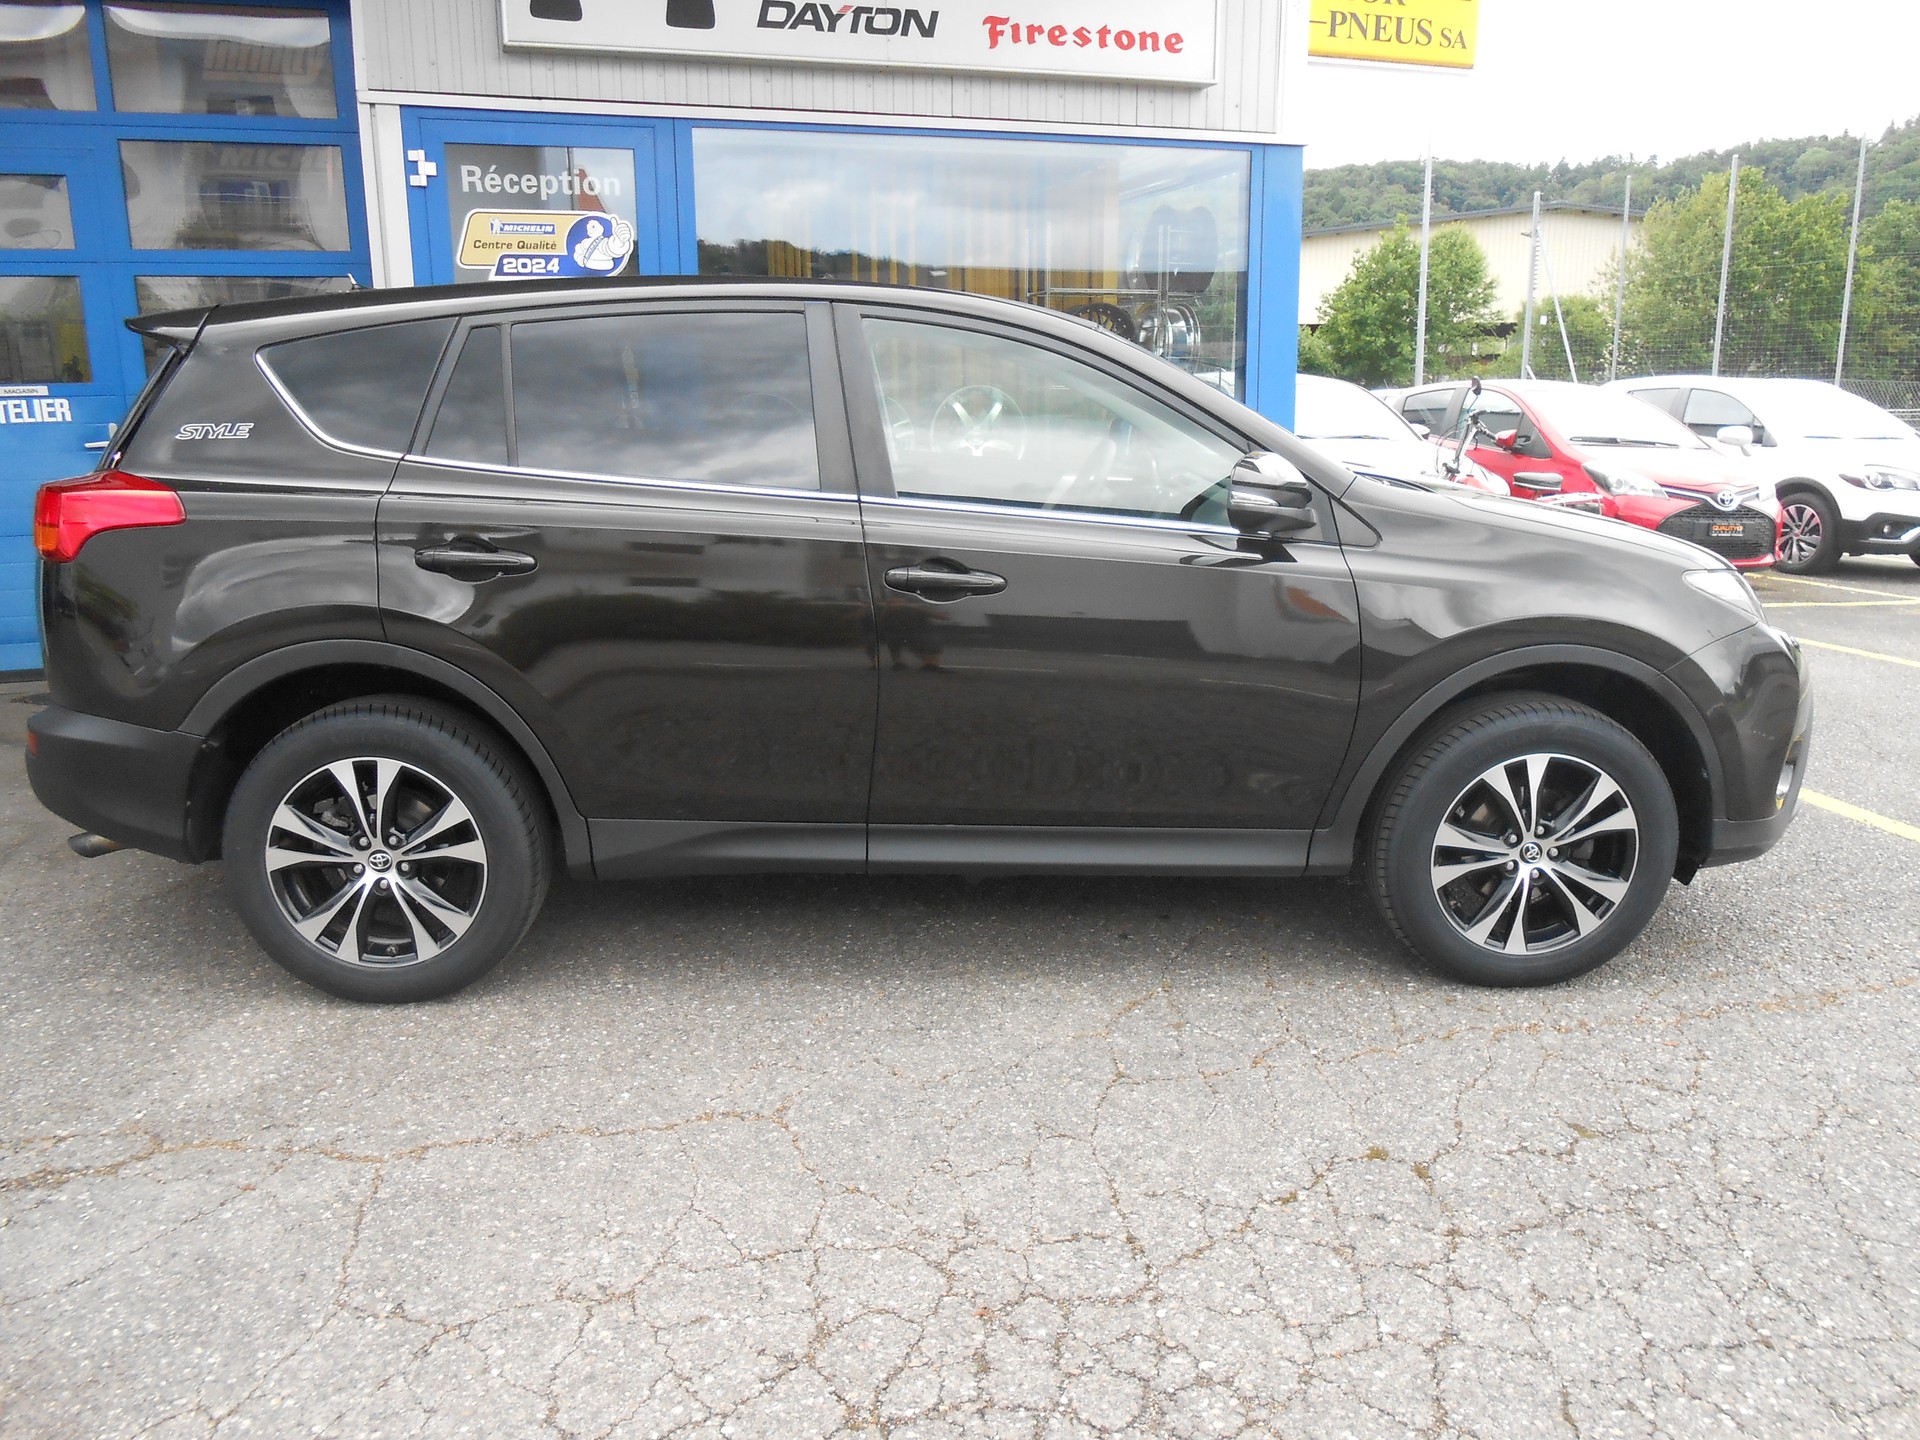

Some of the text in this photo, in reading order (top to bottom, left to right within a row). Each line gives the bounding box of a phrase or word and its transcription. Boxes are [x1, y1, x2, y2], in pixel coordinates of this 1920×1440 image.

[757, 0, 939, 38] DAYTON
[1328, 10, 1468, 49] PNEUS SA
[982, 15, 1184, 54] Firestone
[460, 165, 621, 200] Réception
[502, 224, 554, 233] MICHELIN
[473, 239, 557, 250] Centre Qualité
[502, 257, 560, 274] 2024
[175, 422, 255, 440] STYLE
